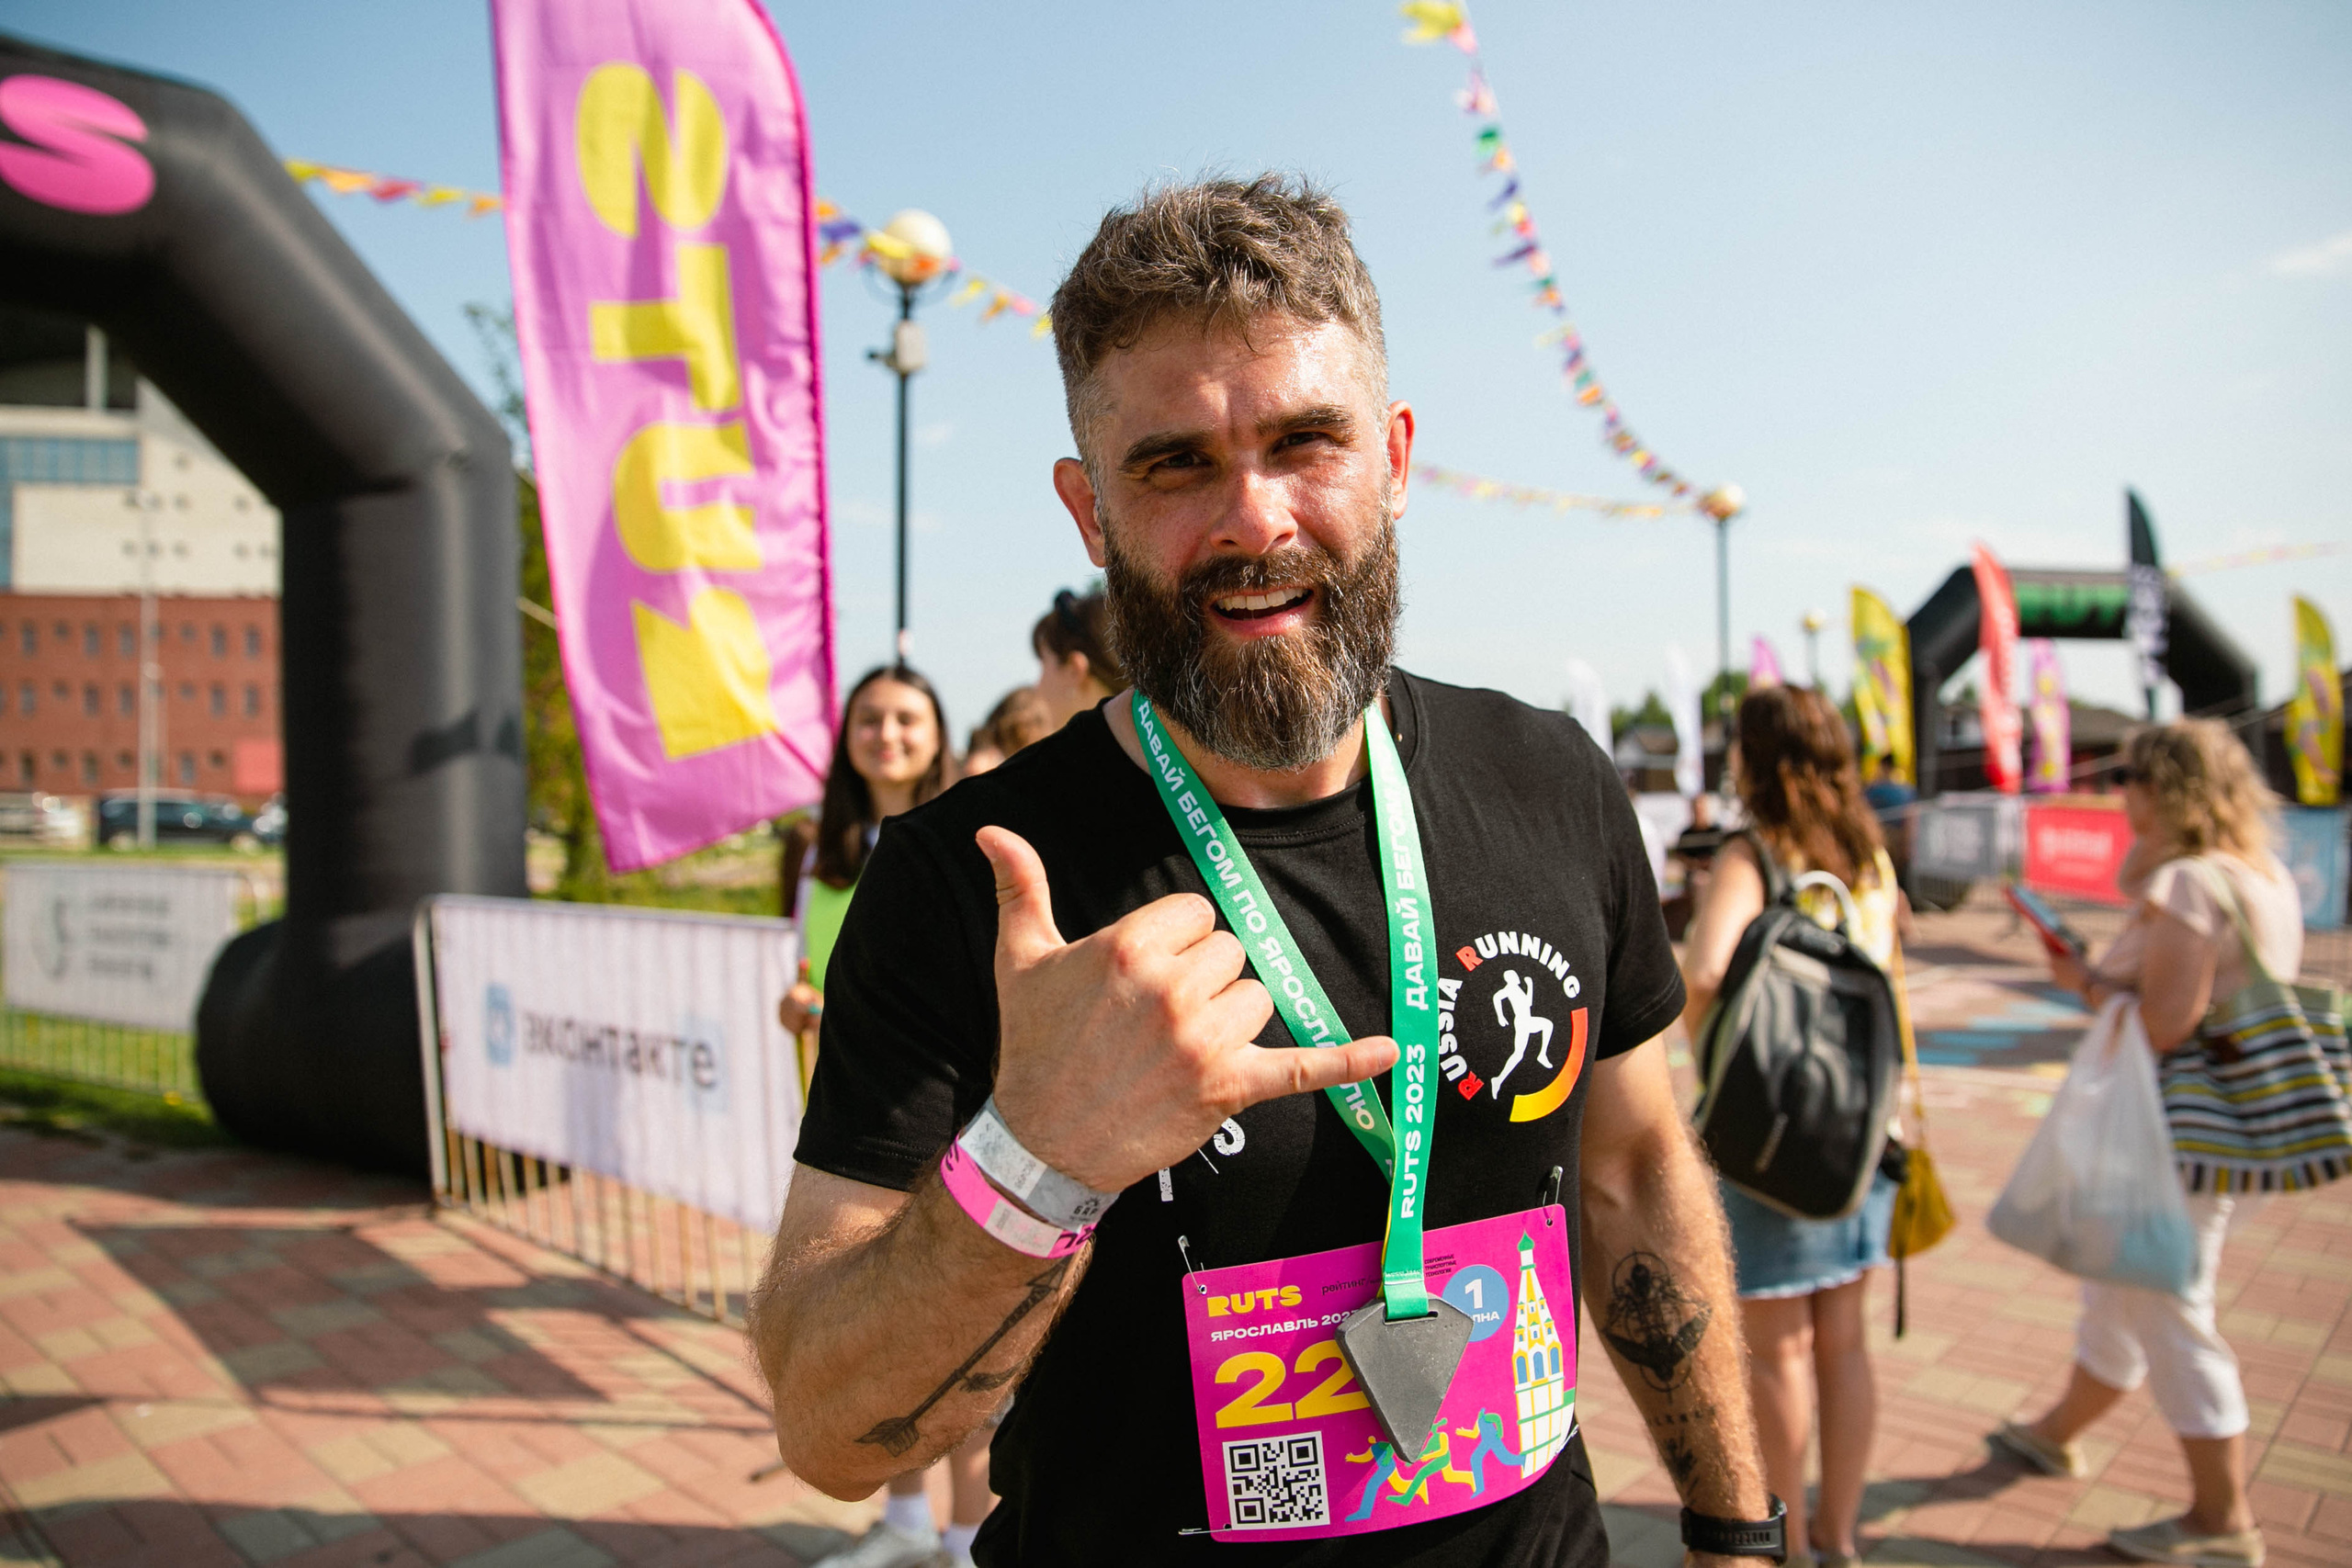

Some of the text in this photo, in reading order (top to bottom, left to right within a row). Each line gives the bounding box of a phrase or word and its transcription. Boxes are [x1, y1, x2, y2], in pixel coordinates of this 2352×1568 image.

[0, 73, 156, 215] S
[1385, 788, 1416, 890] БЕГОМ
[1137, 701, 1375, 1131] ДАВАЙ БЕГОМ ПО ЯРОСЛЛЮ
[1396, 897, 1429, 1011] ДАВАЙ
[1437, 931, 1581, 1100] RUSSIA RUNNING
[1400, 1043, 1426, 1219] RUTS 2023
[1206, 1285, 1303, 1317] RUTS
[1211, 1309, 1360, 1342] ЯРОСЛАВЛЬ 202
[1464, 1279, 1484, 1309] 1
